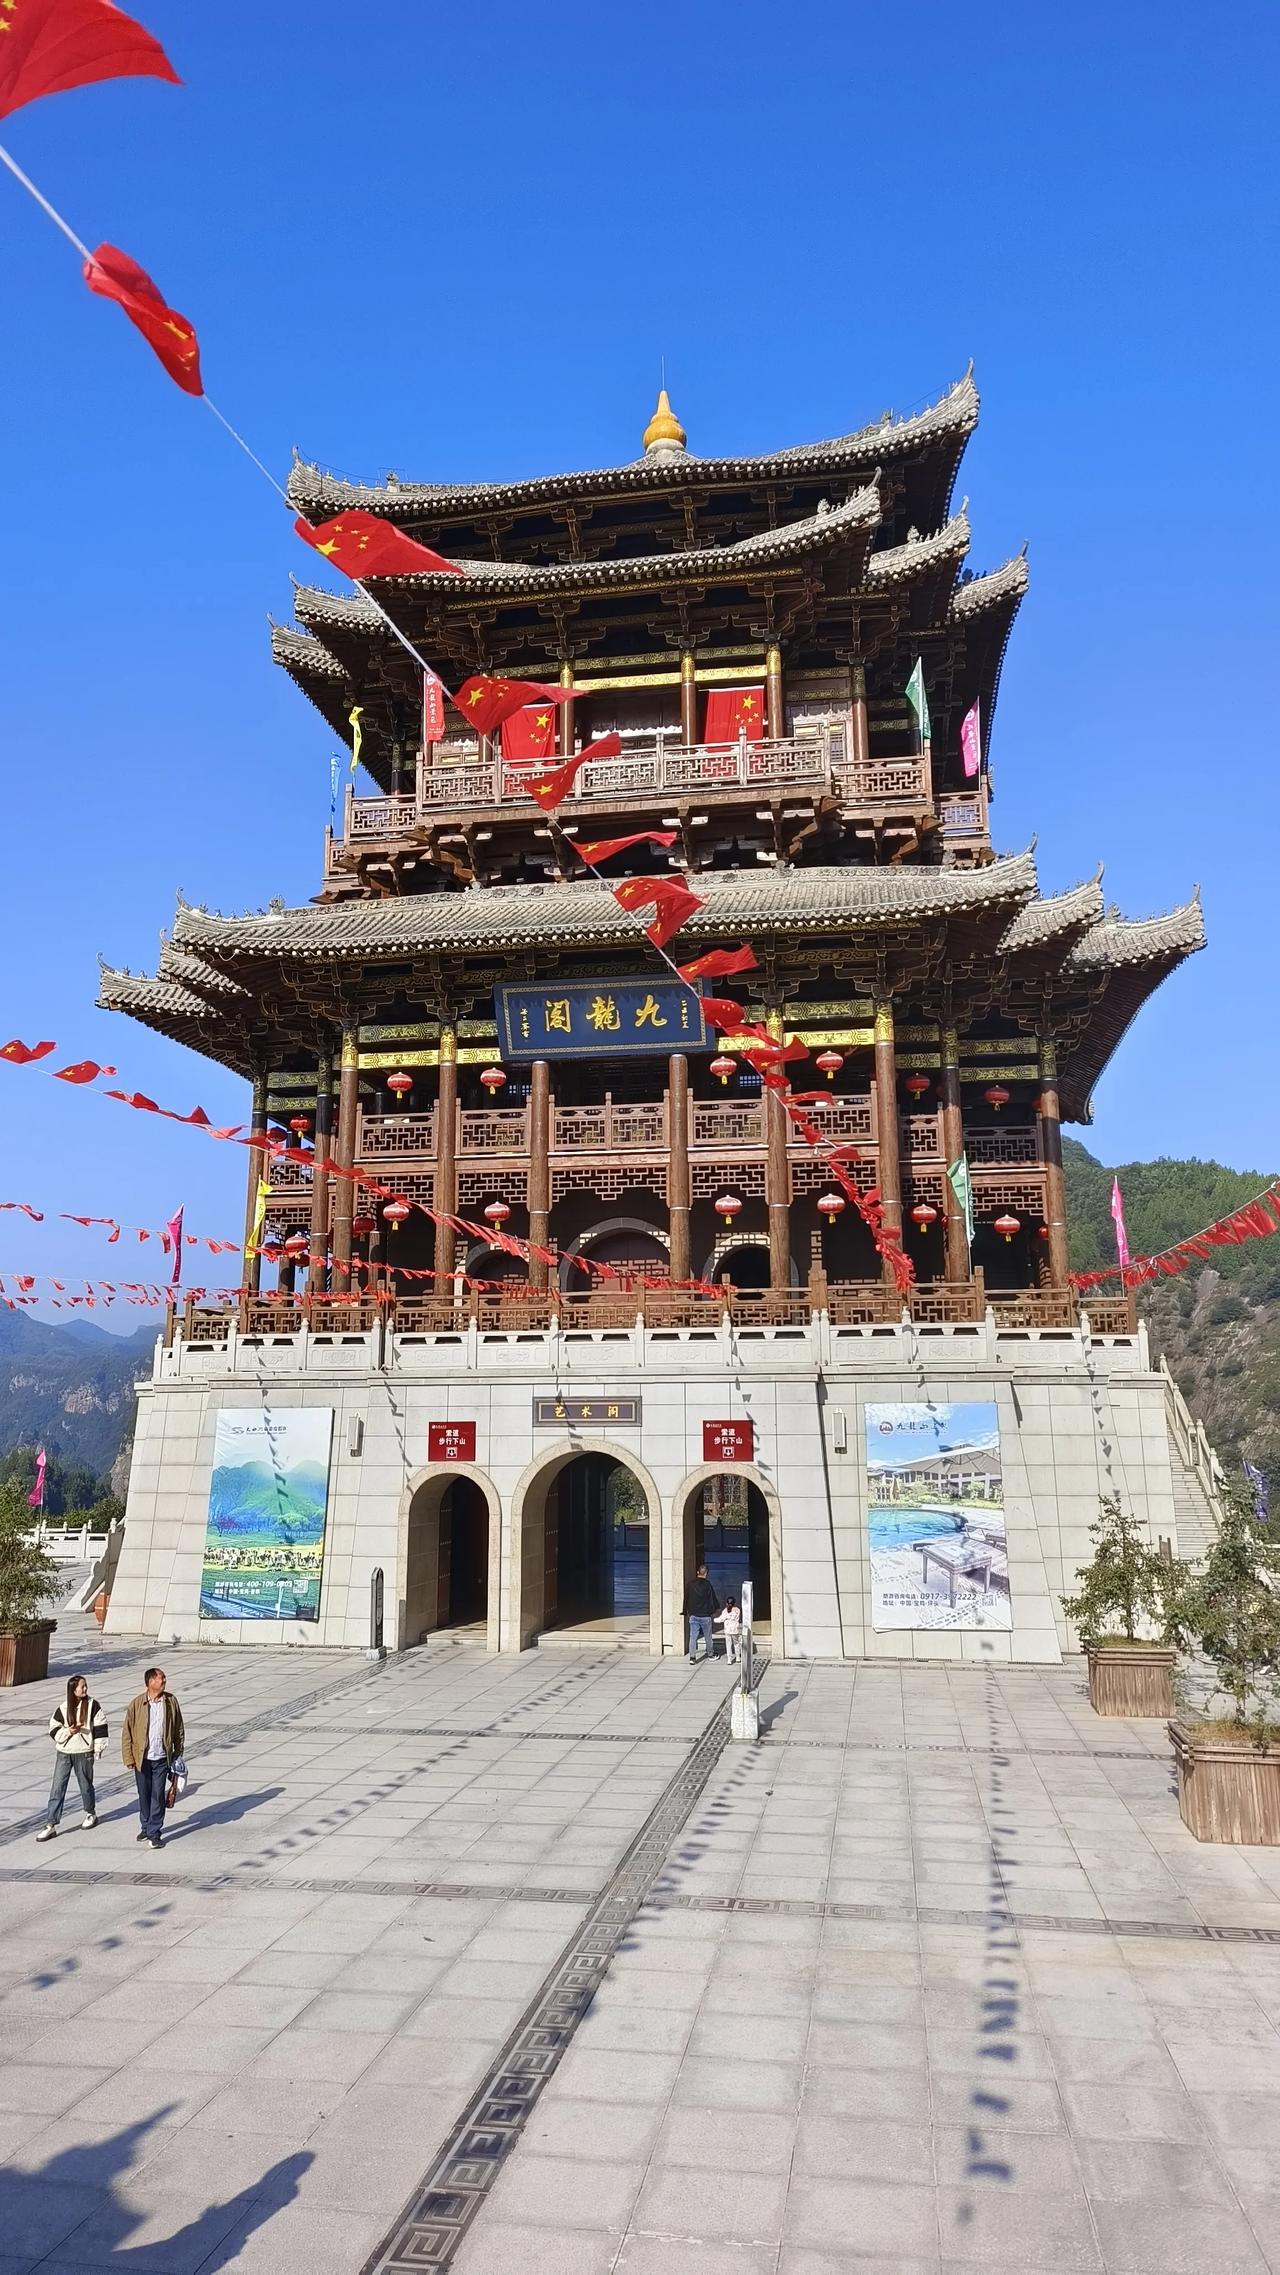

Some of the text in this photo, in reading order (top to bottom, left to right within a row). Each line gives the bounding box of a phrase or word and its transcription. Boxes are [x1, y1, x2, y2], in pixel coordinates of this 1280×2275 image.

[438, 1437, 466, 1445] 步行下山
[713, 1436, 743, 1445] 步行下山
